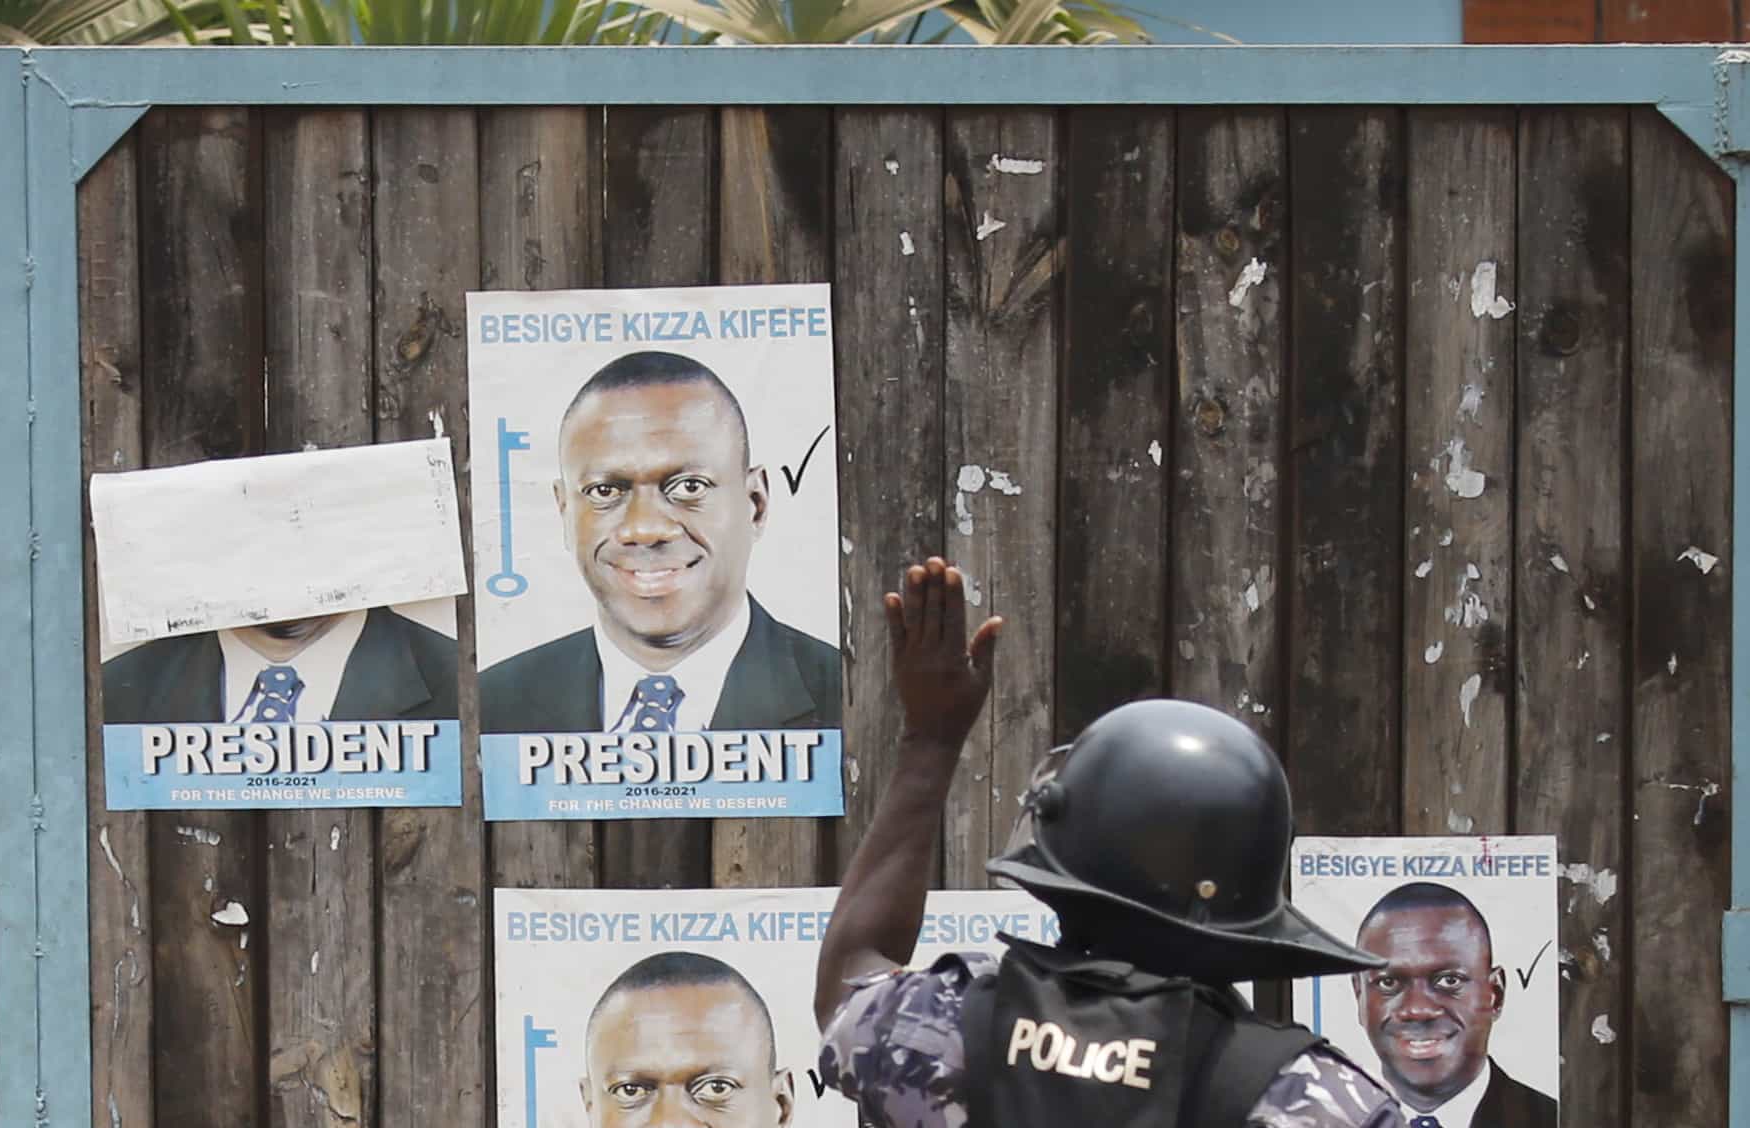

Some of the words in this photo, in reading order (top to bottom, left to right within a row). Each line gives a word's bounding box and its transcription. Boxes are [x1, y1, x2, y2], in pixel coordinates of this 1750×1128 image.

[480, 312, 612, 344] BESIGYE
[622, 310, 711, 340] KIZZA
[719, 307, 826, 338] KIFEFE
[143, 723, 434, 776] PRESIDENT
[518, 732, 819, 784] PRESIDENT
[171, 789, 202, 801] FOR
[206, 789, 235, 800] THE
[240, 788, 302, 800] CHANGE
[306, 788, 330, 799] WE
[336, 787, 404, 799] DESERVE
[246, 776, 316, 786] 2016-2021
[625, 786, 696, 795] 2016-2021
[548, 800, 578, 811] FOR
[585, 799, 614, 810] THE
[619, 798, 682, 810] CHANGE
[687, 798, 710, 809] WE
[717, 797, 786, 809] DESERVE
[1300, 855, 1395, 876] BESIGYE
[1403, 855, 1466, 876] KIZZA
[1472, 855, 1549, 876] KIFEFE
[508, 912, 640, 941] BESIGYE
[650, 912, 738, 941] KIZZA
[748, 912, 831, 941] KIFEF
[919, 913, 1029, 943] ESIGYE
[1008, 1018, 1156, 1089] POLICE
